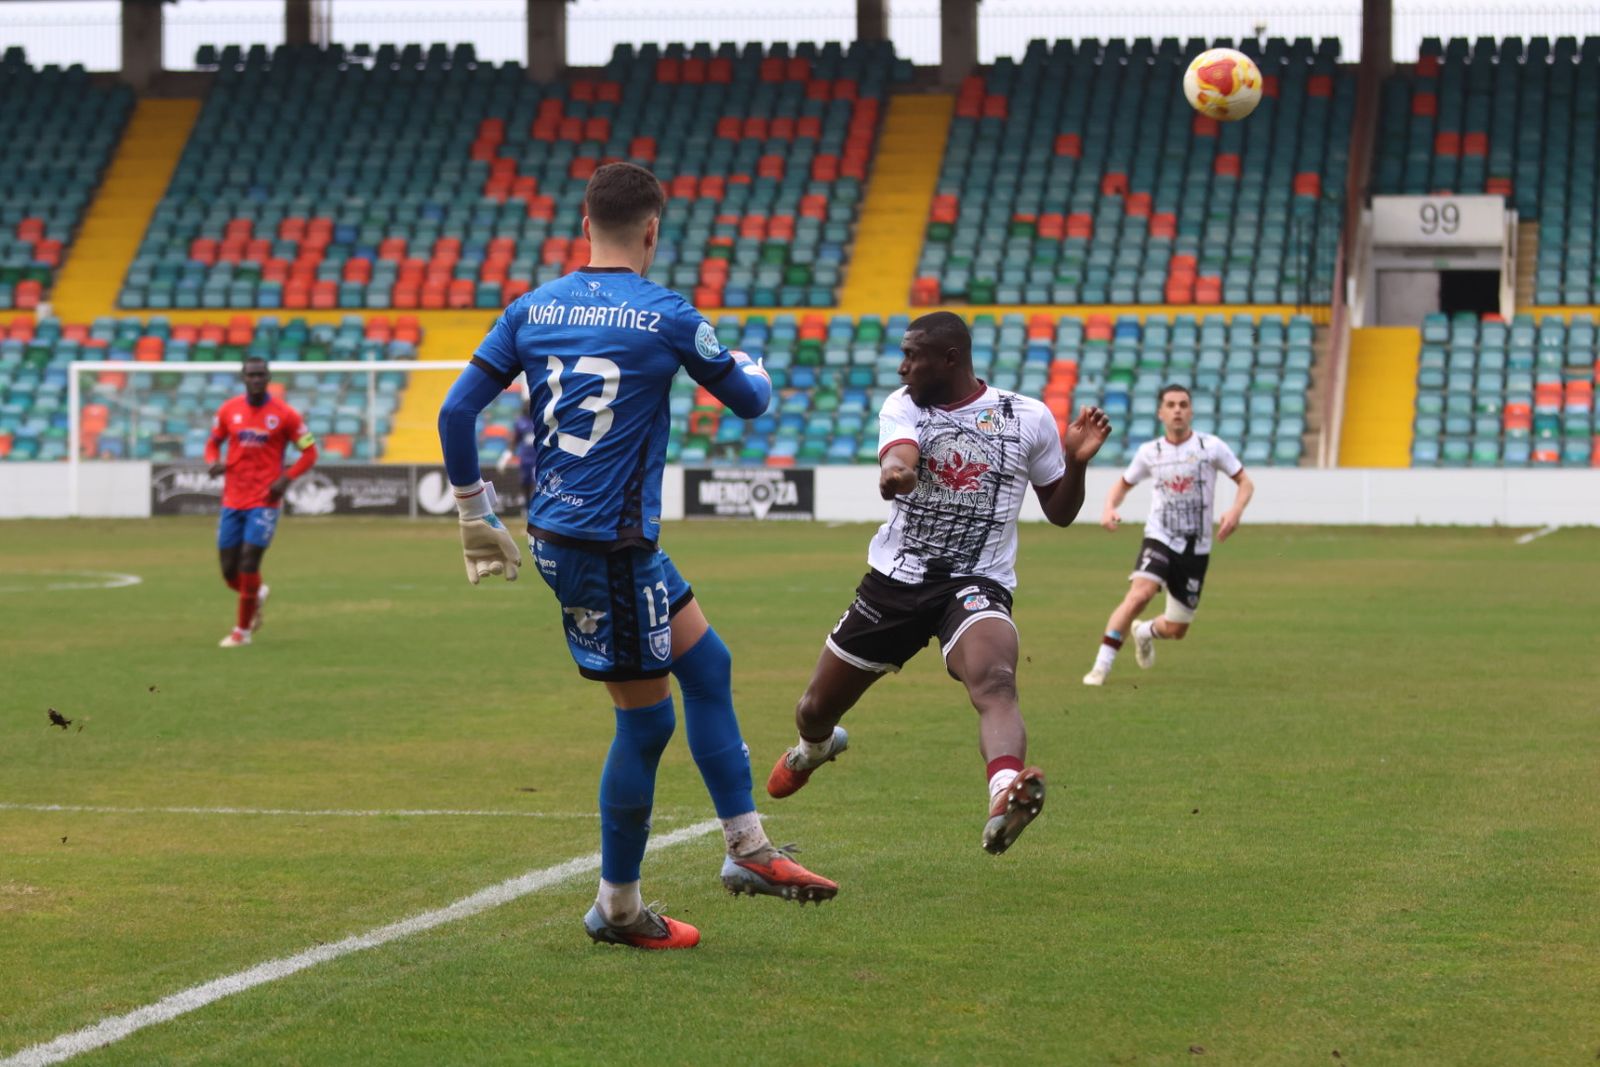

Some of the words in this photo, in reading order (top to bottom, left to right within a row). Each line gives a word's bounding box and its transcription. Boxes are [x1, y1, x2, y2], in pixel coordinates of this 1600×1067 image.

[1419, 201, 1460, 235] 99
[528, 299, 565, 325] IVÁN
[567, 301, 661, 333] MARTÍNEZ
[543, 355, 621, 458] 13
[916, 481, 994, 510] SALAMANCA
[642, 581, 670, 627] 13
[568, 626, 608, 656] Soria
